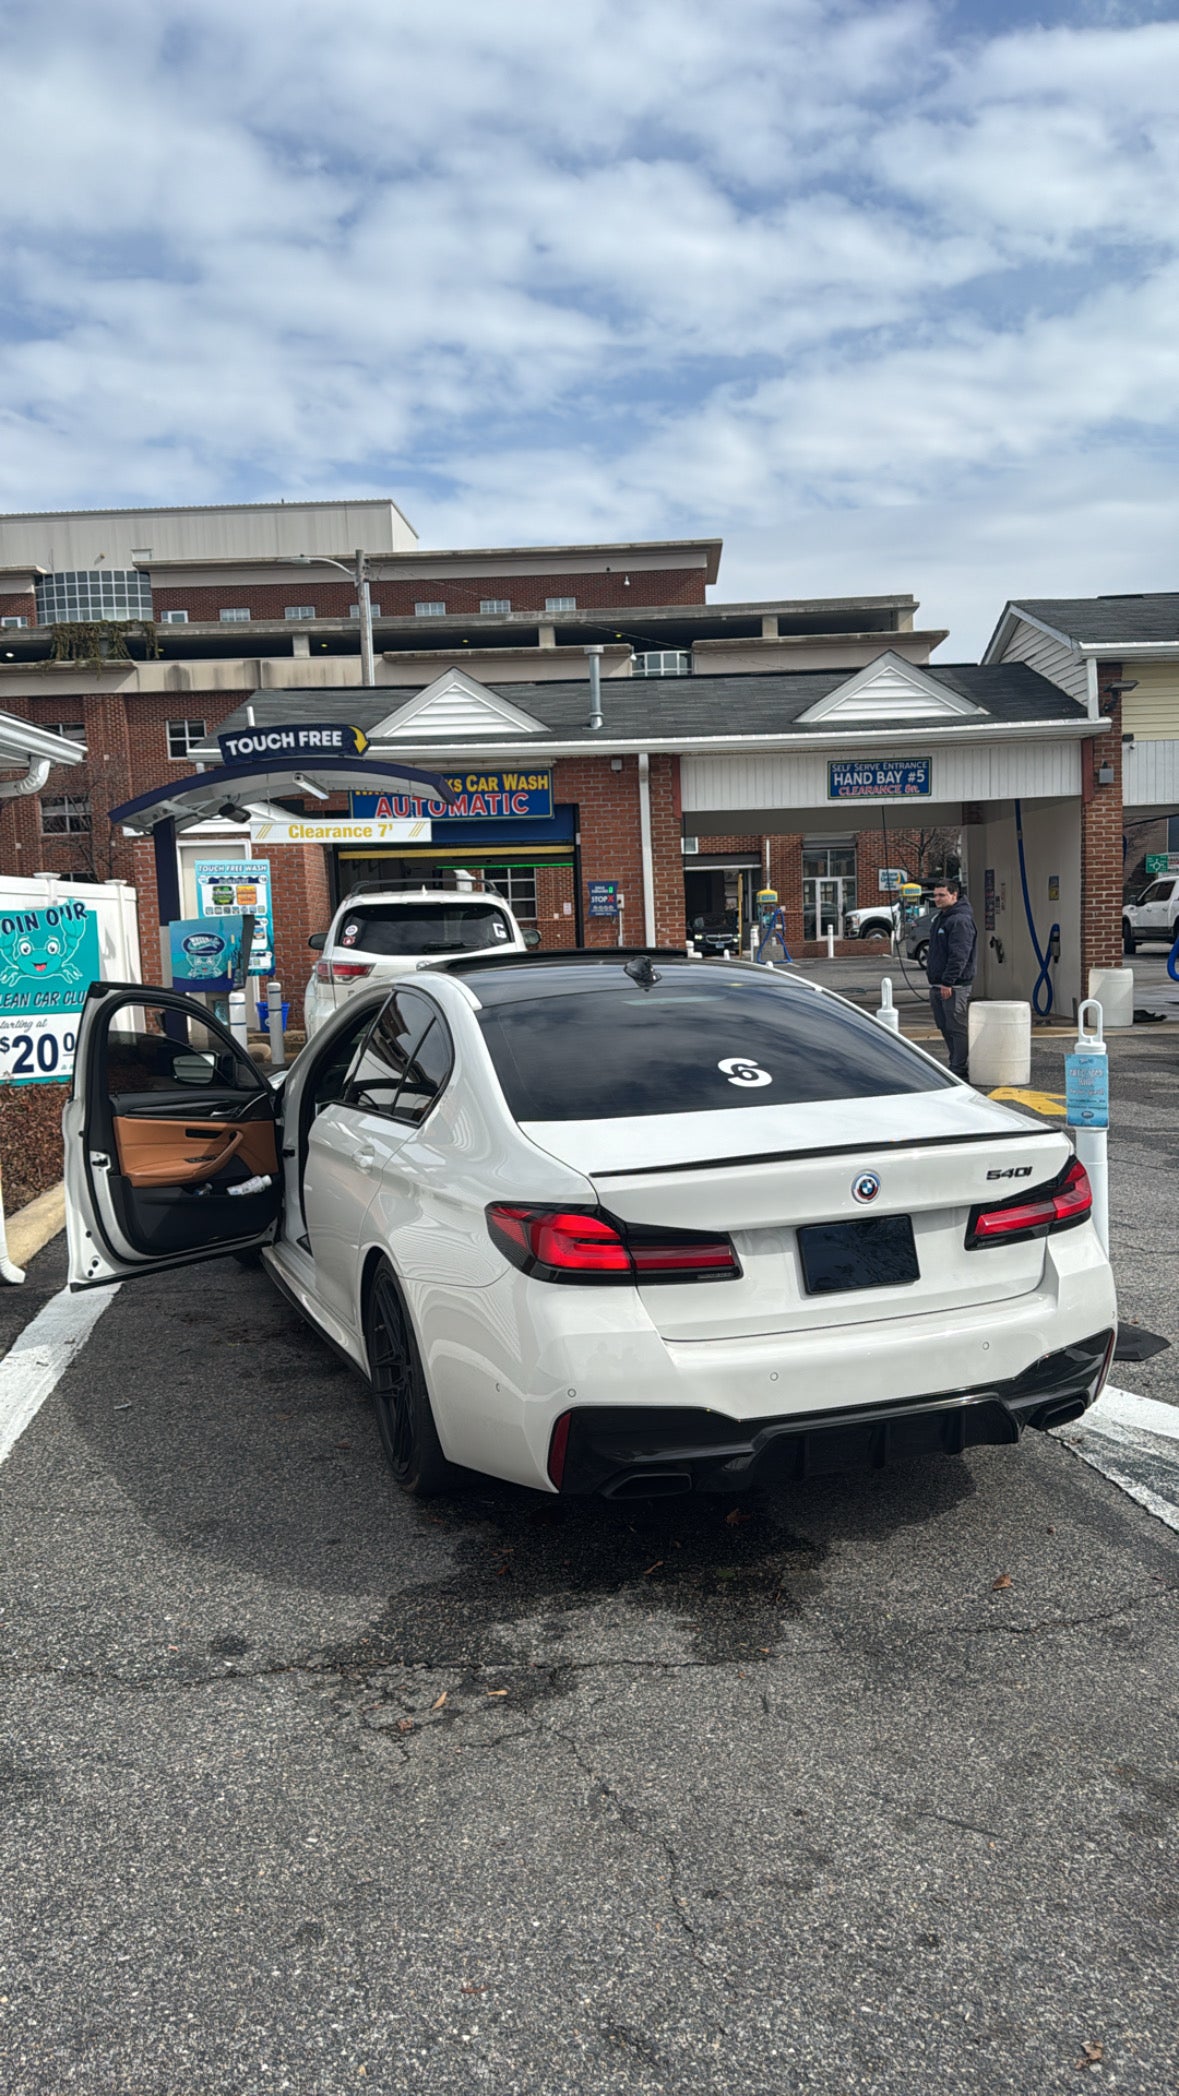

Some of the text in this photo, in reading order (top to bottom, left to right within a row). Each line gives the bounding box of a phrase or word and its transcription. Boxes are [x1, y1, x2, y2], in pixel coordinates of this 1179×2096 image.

[226, 730, 343, 756] TOUCH FREE
[832, 760, 928, 773] SELF SERVE ENTRANCE
[465, 774, 499, 793] CAR
[502, 773, 549, 791] WASH
[834, 769, 926, 786] HAND BAY #5
[838, 784, 903, 797] CLEARANCE
[375, 792, 530, 819] AUTOMATIC
[288, 823, 394, 839] Clearance 7'
[198, 864, 267, 873] TOUCH FREE WASH
[591, 895, 608, 904] STOP
[1, 911, 39, 935] OIN
[492, 922, 508, 939] G
[0, 990, 87, 1009] LEAN CAR CLU
[0, 1018, 48, 1033] tarting at
